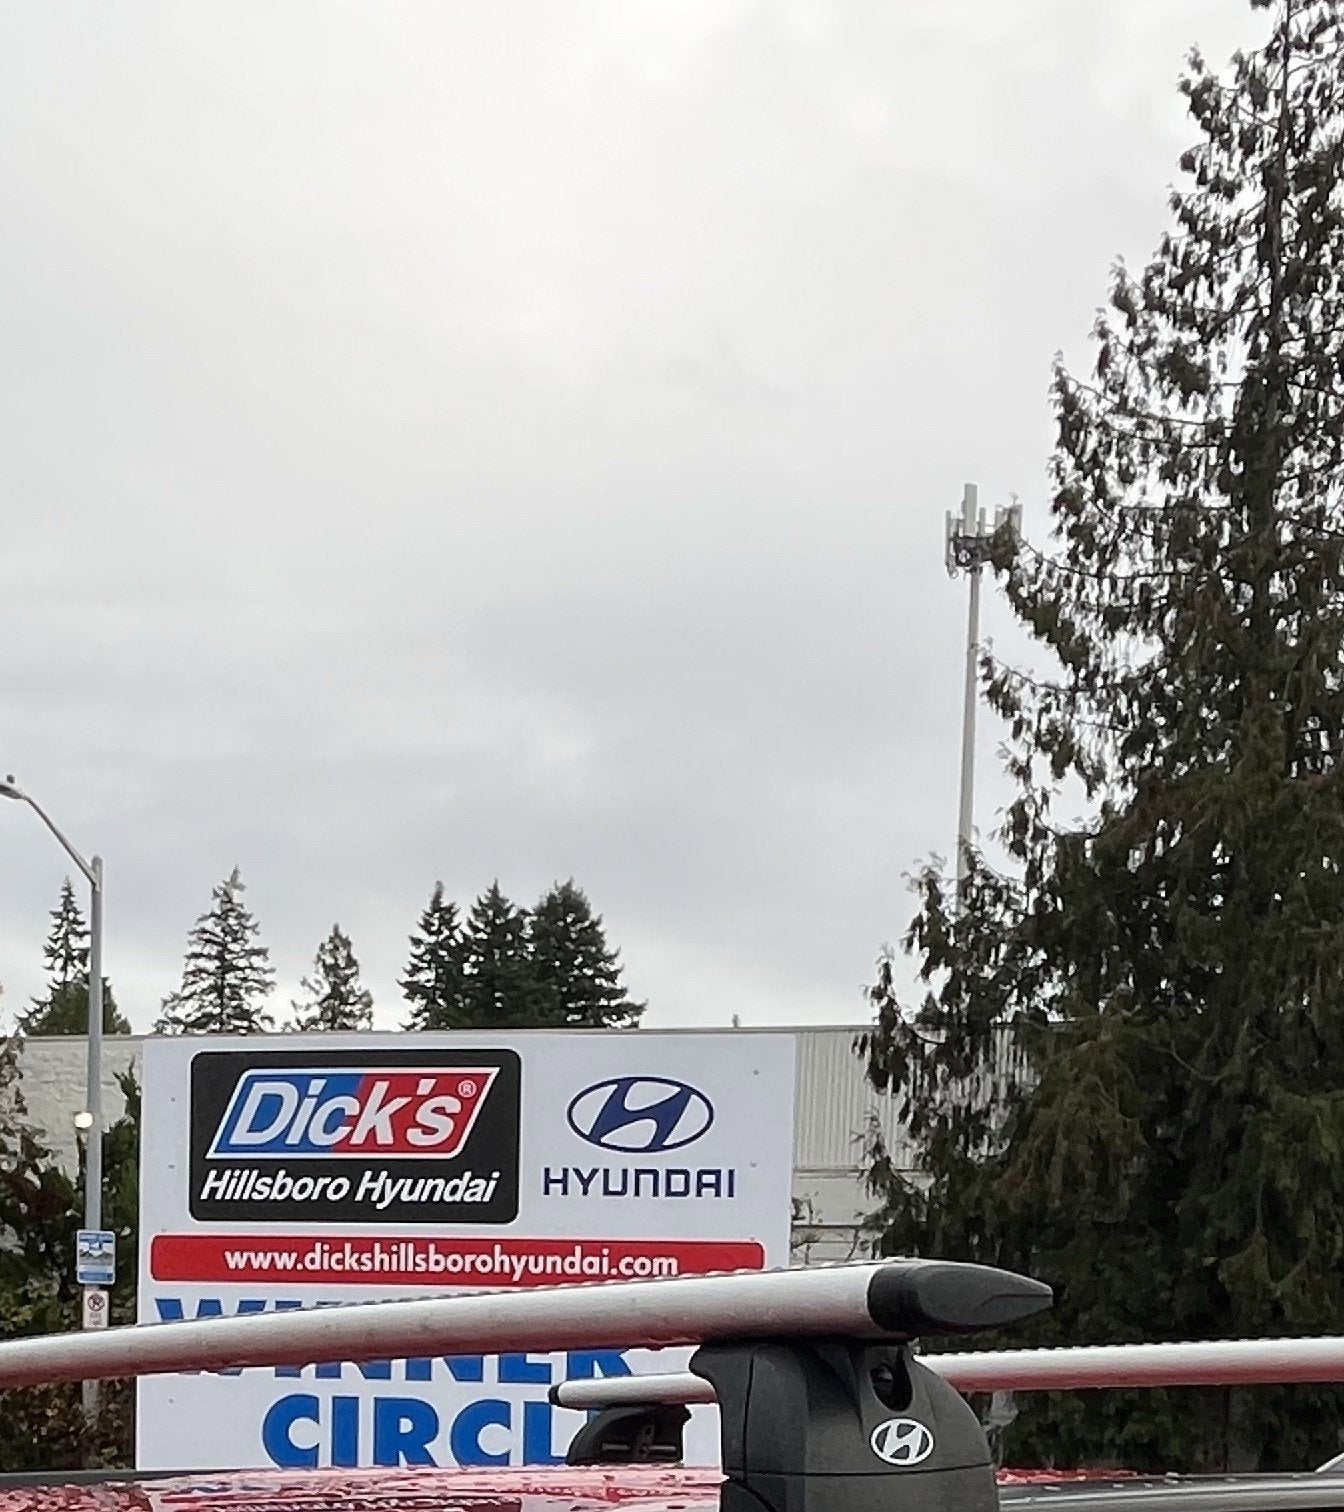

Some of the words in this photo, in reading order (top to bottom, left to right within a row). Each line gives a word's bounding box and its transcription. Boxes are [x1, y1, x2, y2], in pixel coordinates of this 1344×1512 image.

[199, 1169, 351, 1202] Hillsboro
[357, 1171, 499, 1210] Hyundai
[543, 1167, 735, 1198] HYUNDAI
[225, 1243, 678, 1281] www.dickshillsborohyundai.com
[262, 1393, 602, 1468] CIRCL
